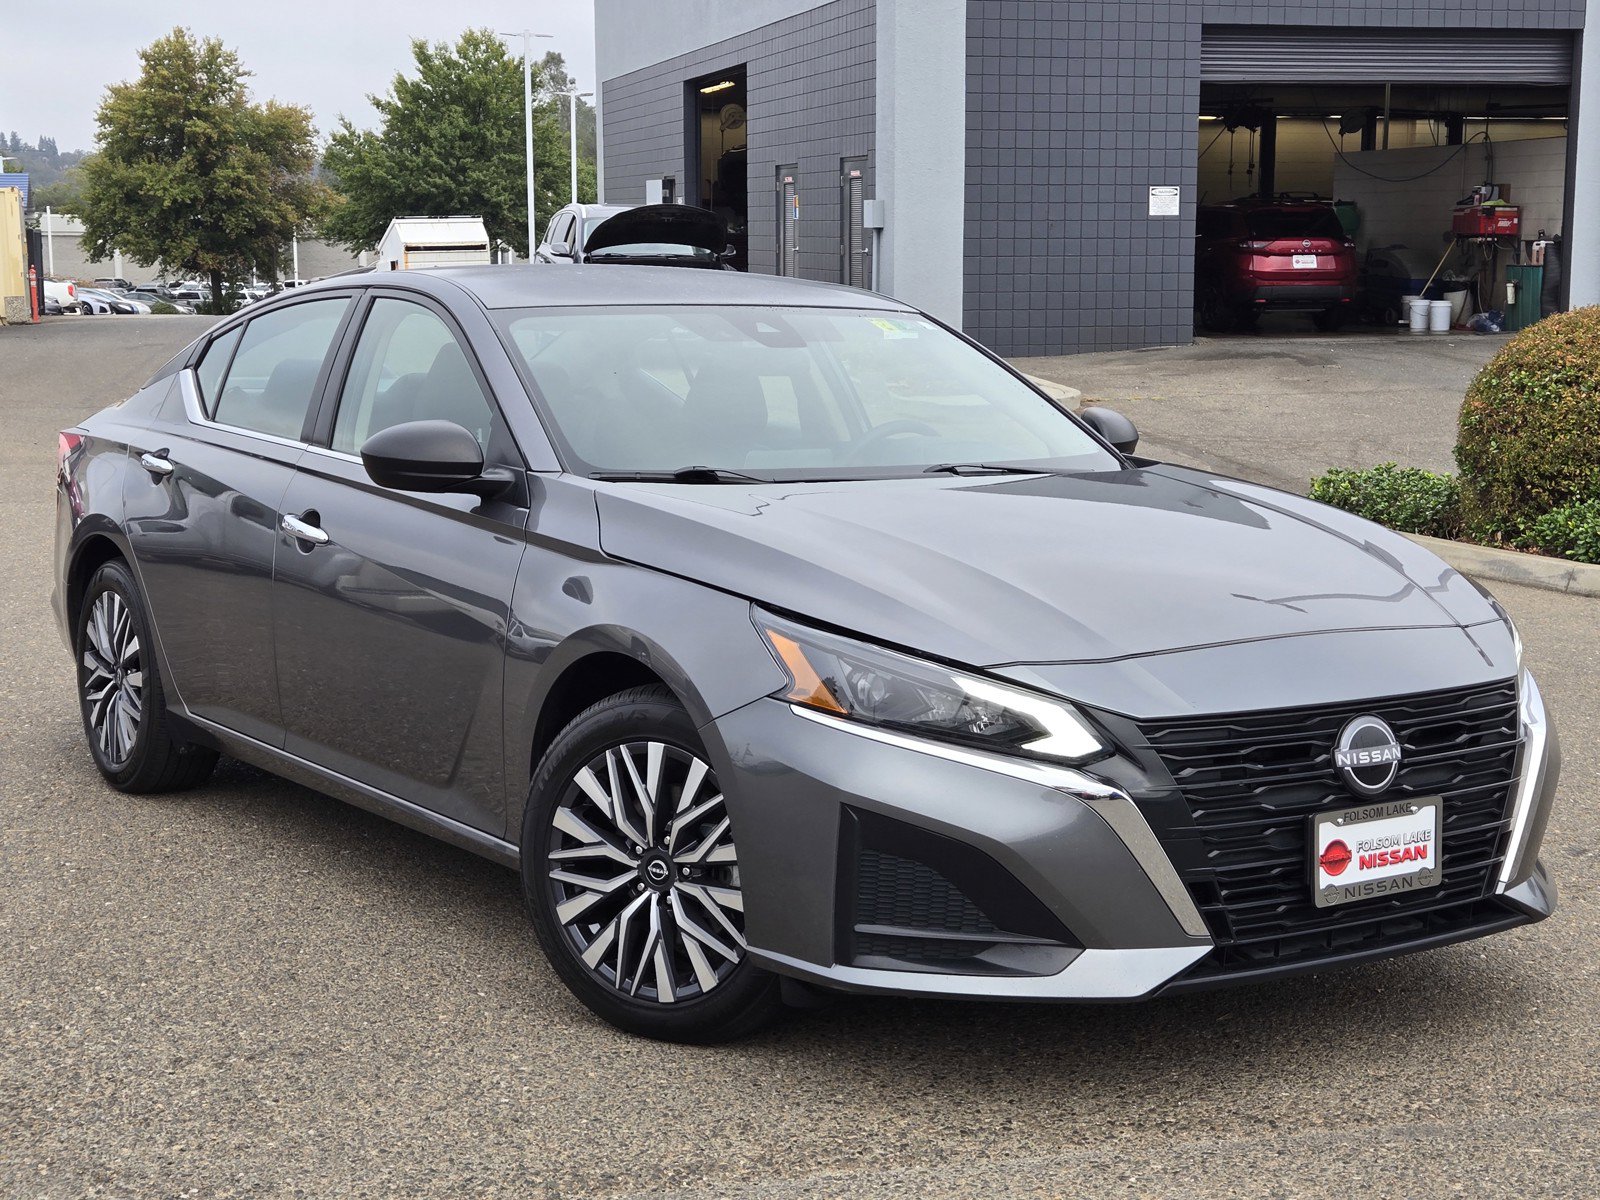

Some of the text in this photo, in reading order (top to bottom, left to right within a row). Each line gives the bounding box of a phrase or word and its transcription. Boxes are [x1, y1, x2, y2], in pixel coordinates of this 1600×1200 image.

[1337, 746, 1401, 766] NISSAN
[1344, 802, 1412, 822] FOLSOM LAKE
[1356, 829, 1432, 853] FOLSOM LAKE
[1359, 844, 1428, 870] NISSAN
[1344, 875, 1414, 900] NISSAN
